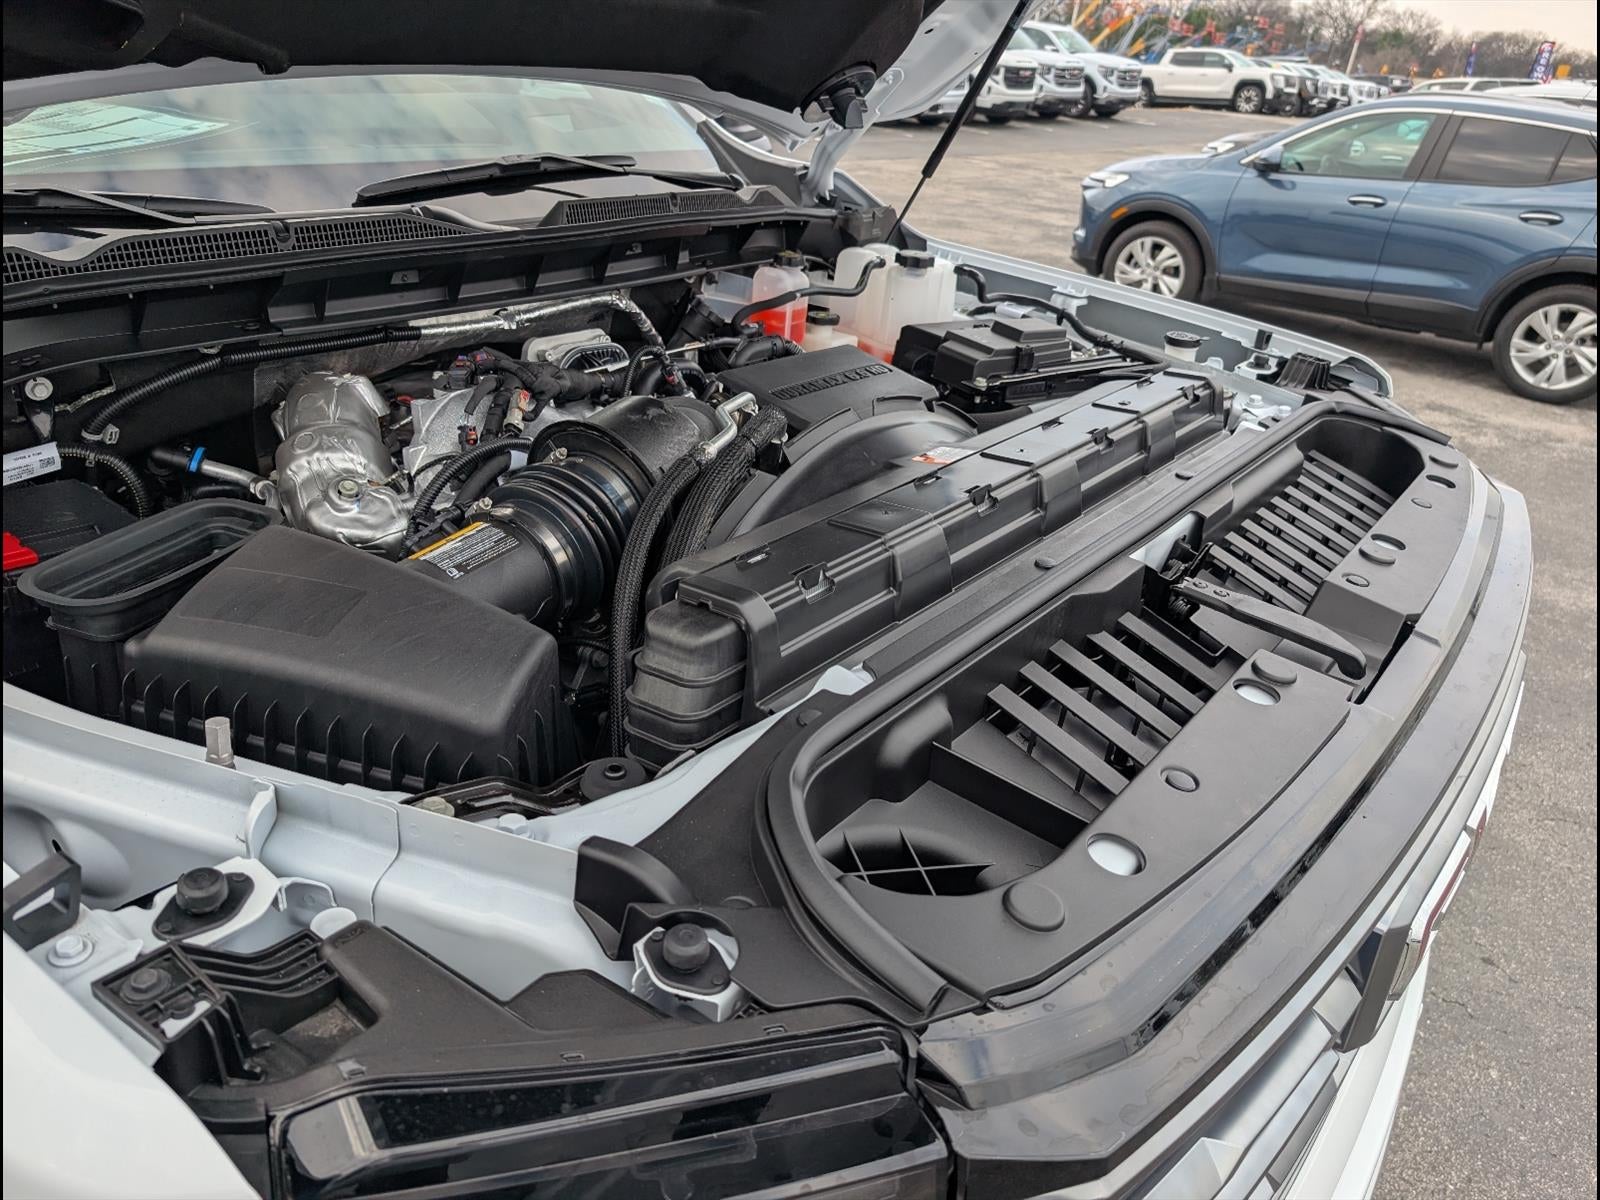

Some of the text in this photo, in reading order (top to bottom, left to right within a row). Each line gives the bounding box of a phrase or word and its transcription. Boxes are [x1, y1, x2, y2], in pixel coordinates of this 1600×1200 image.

[771, 365, 889, 400] DURAMAX 6.6 HD
